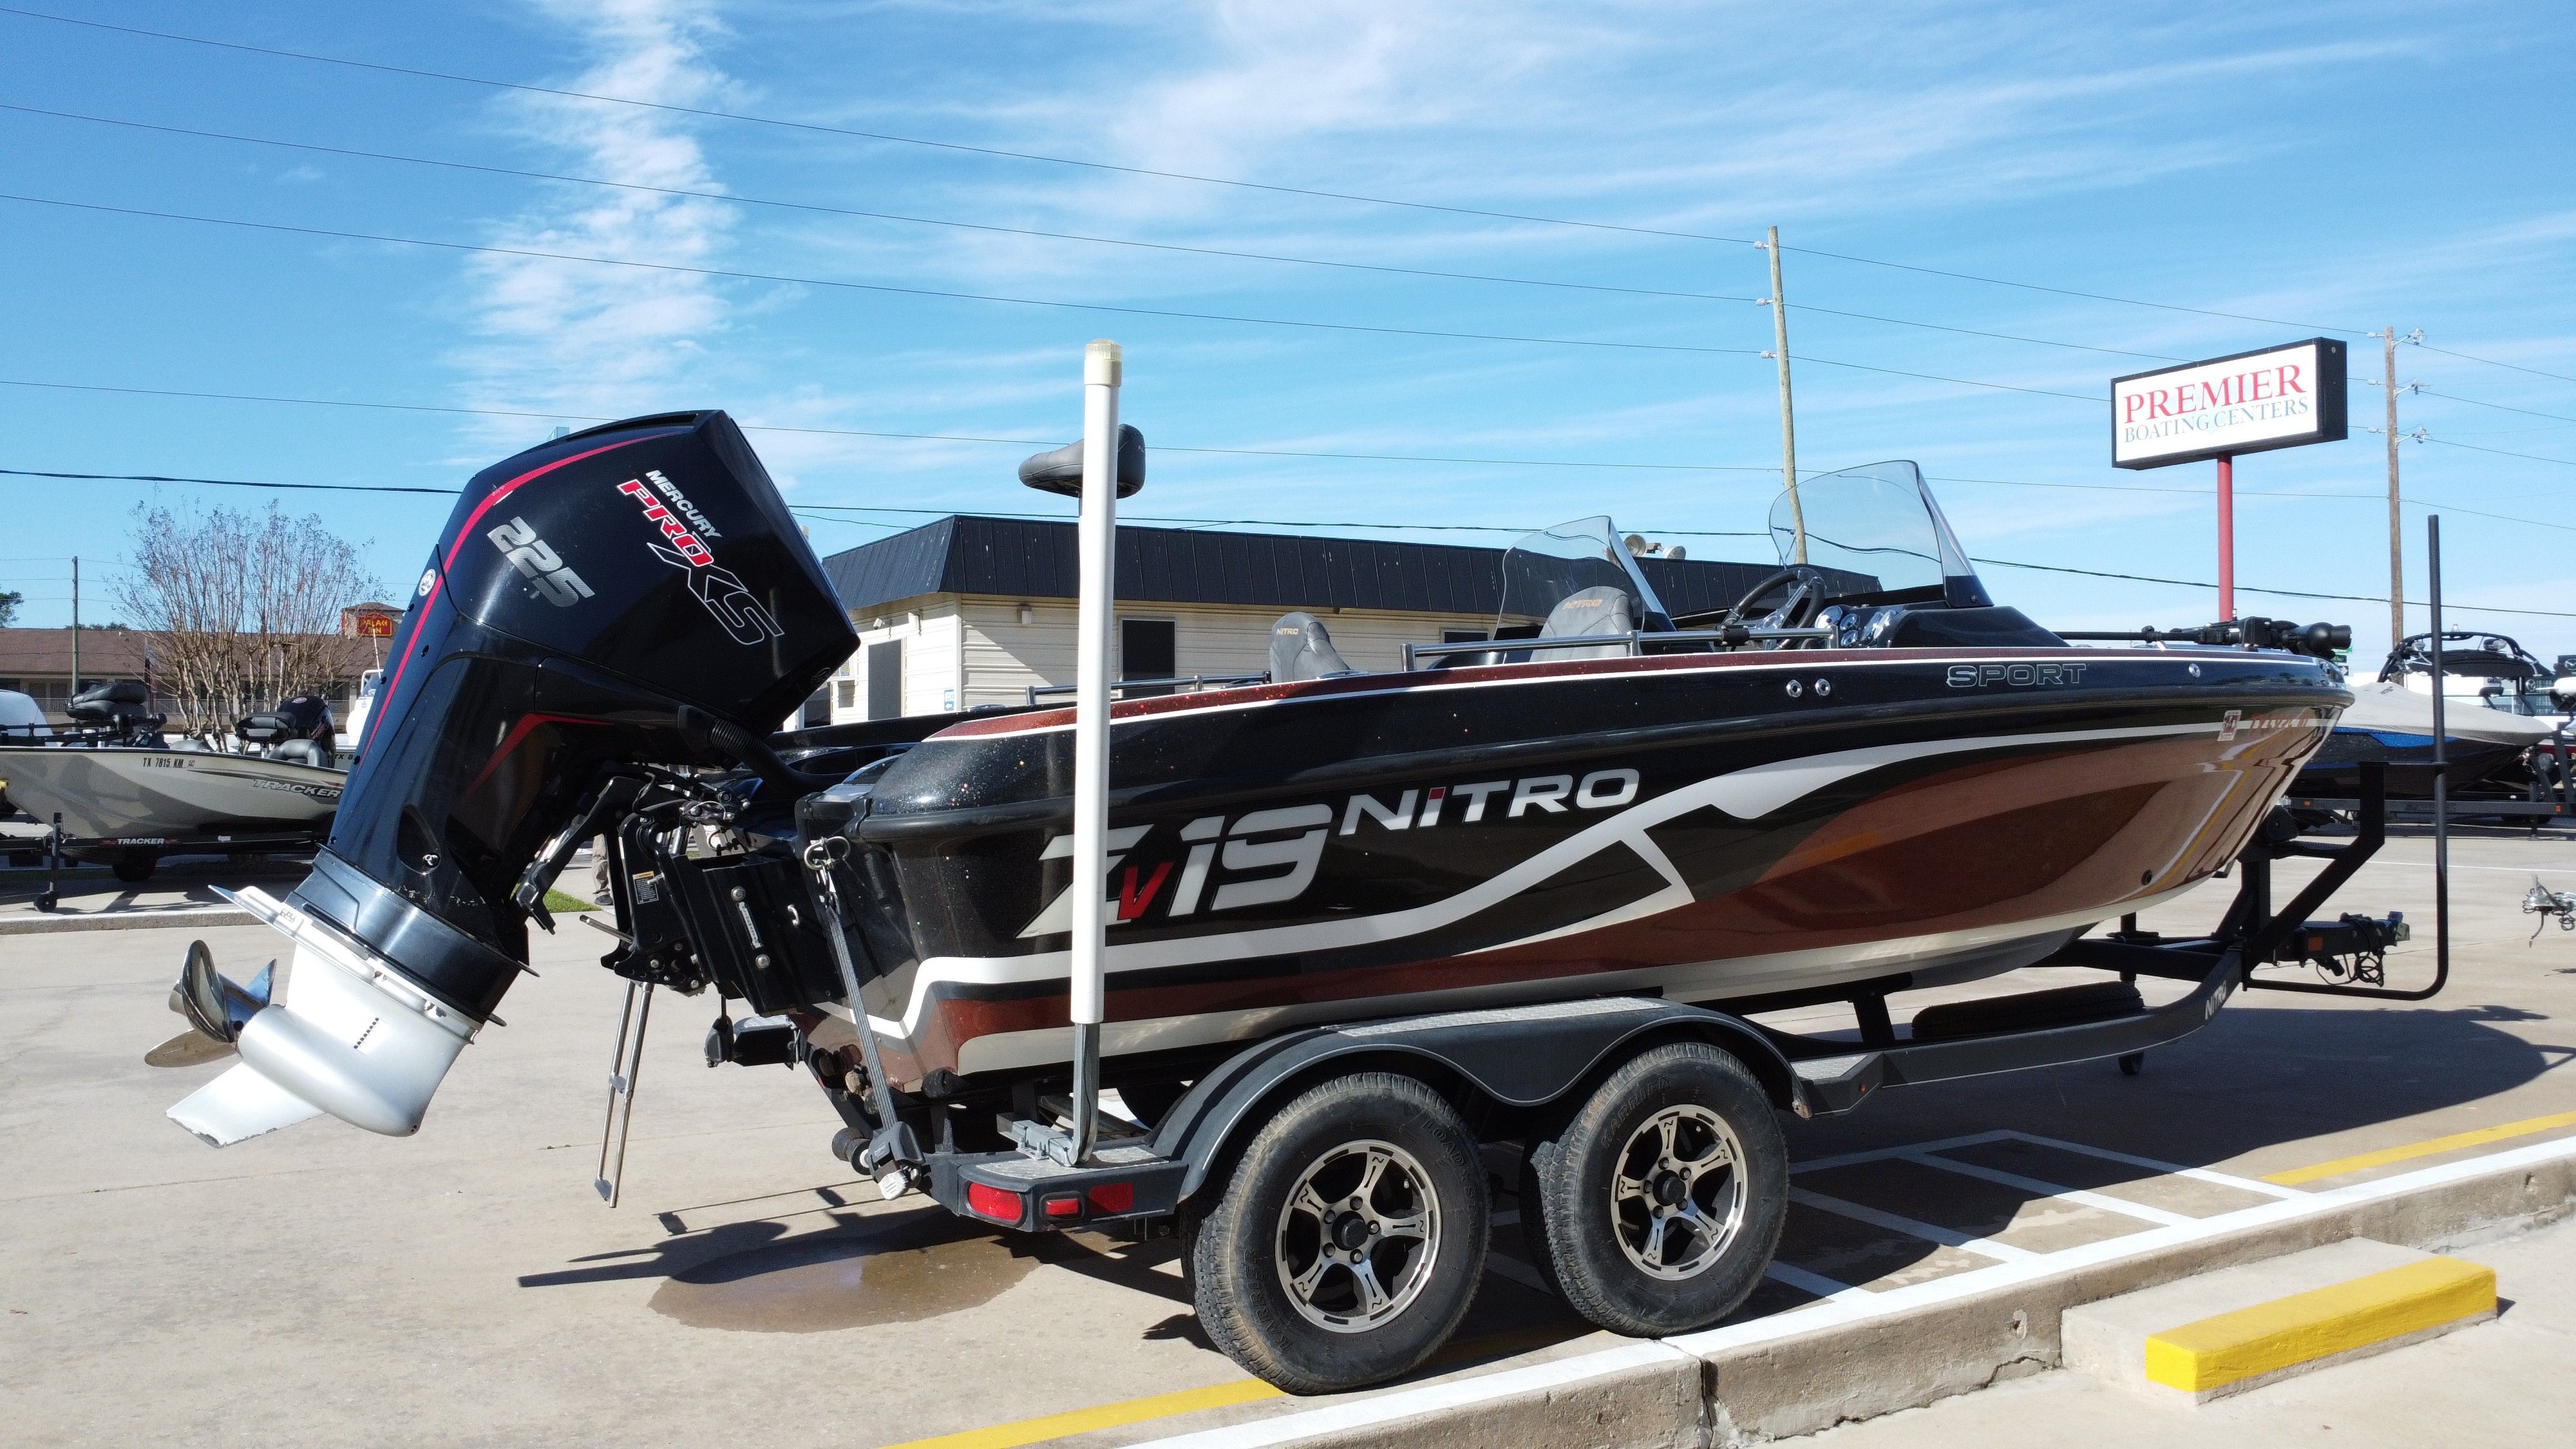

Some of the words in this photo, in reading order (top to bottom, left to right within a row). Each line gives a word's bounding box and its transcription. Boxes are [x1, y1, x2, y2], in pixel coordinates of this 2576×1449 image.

[2123, 364, 2307, 423] PREMIER
[2124, 414, 2210, 442] BOATING
[2213, 397, 2307, 428] CENTERS
[616, 479, 714, 567] PRO
[646, 469, 722, 538] MERCURY
[486, 516, 595, 607] 225
[647, 531, 785, 645] XS
[1946, 663, 2087, 687] SPORT
[143, 757, 152, 767] TX
[155, 757, 171, 768] 7815
[173, 758, 184, 768] KM
[254, 779, 341, 799] TRACKER
[2205, 980, 2226, 1020] NITRO
[1243, 1248, 1293, 1350] KARRIER
